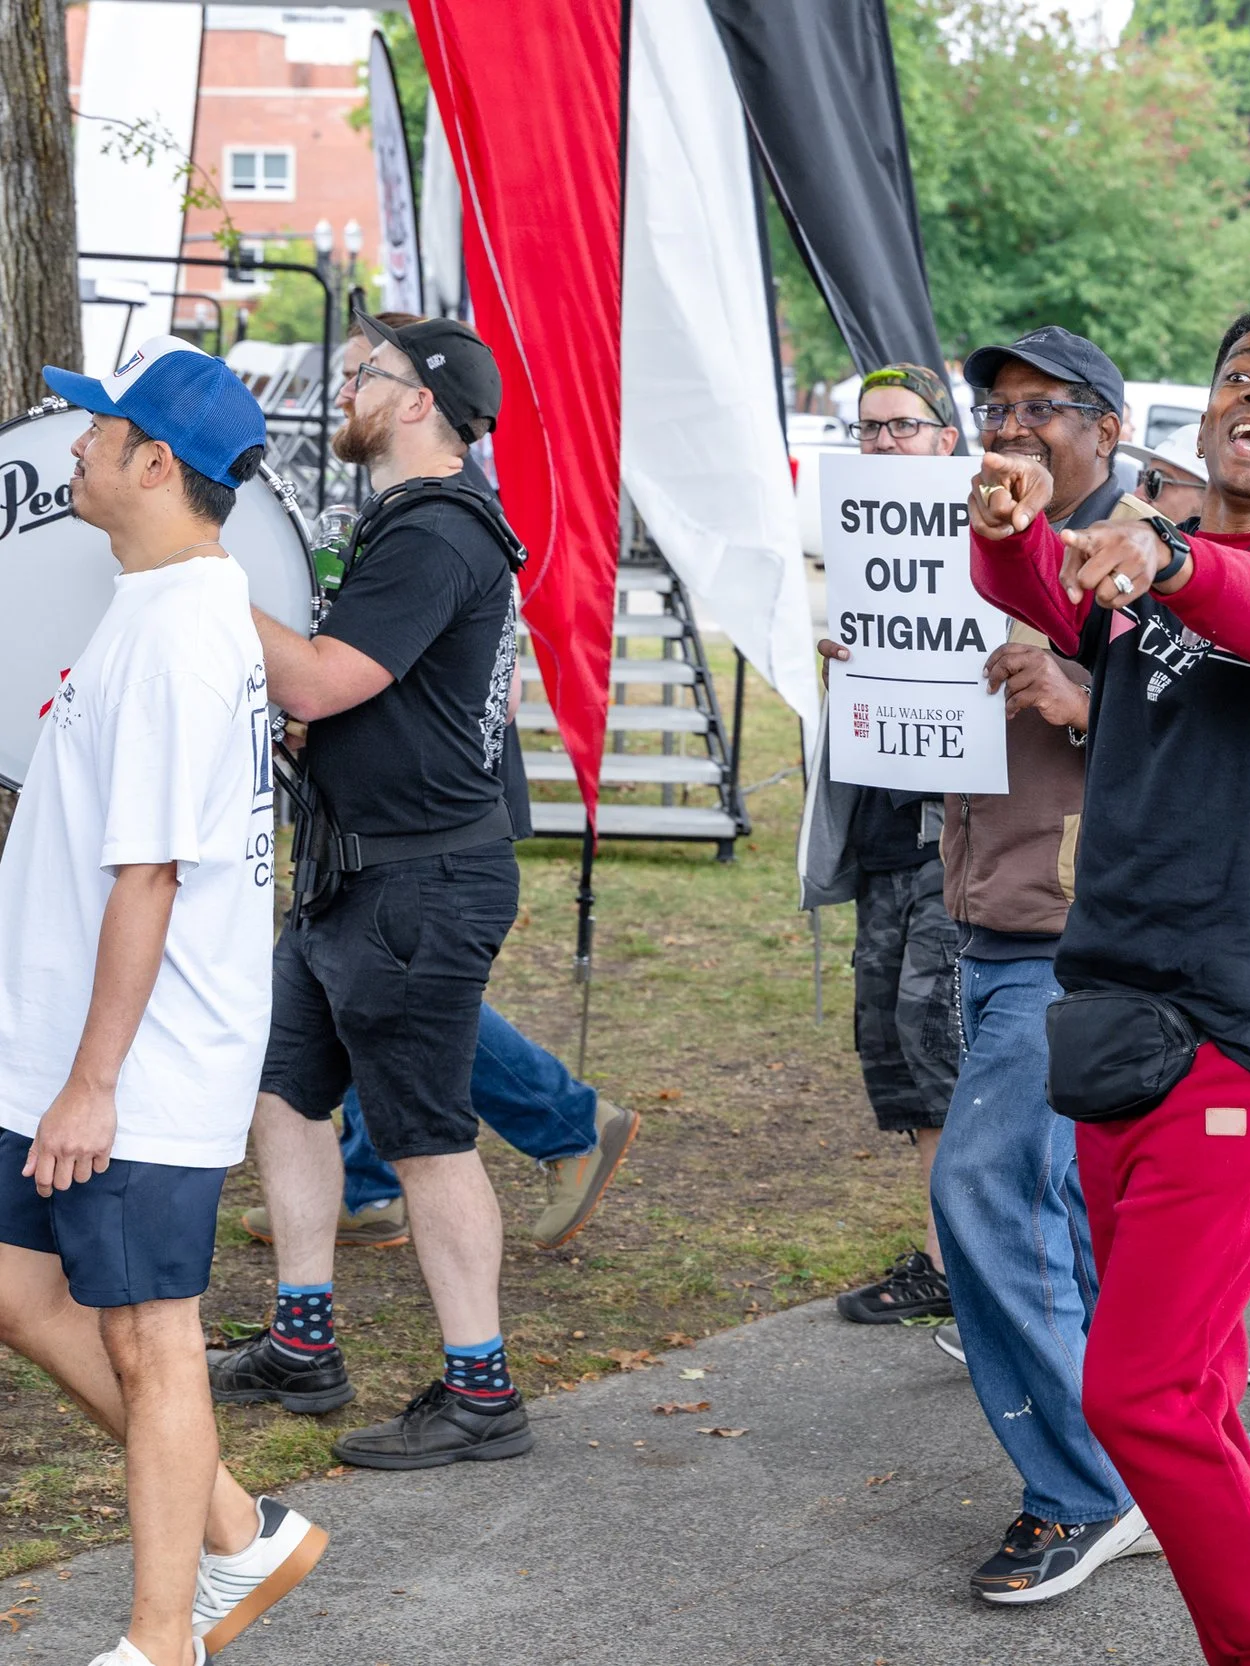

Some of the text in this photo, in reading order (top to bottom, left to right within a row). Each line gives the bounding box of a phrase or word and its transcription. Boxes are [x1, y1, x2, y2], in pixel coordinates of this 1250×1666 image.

[0, 460, 72, 540] Pea
[840, 499, 970, 537] STOMP
[865, 557, 944, 594] OUT
[840, 612, 987, 652] STIGMA
[1138, 618, 1205, 676] LIF
[853, 703, 869, 712] AIDS
[853, 711, 869, 721] WALK
[876, 705, 964, 722] ALL WALKS OF
[854, 729, 870, 739] WEST
[876, 720, 965, 759] LIFE
